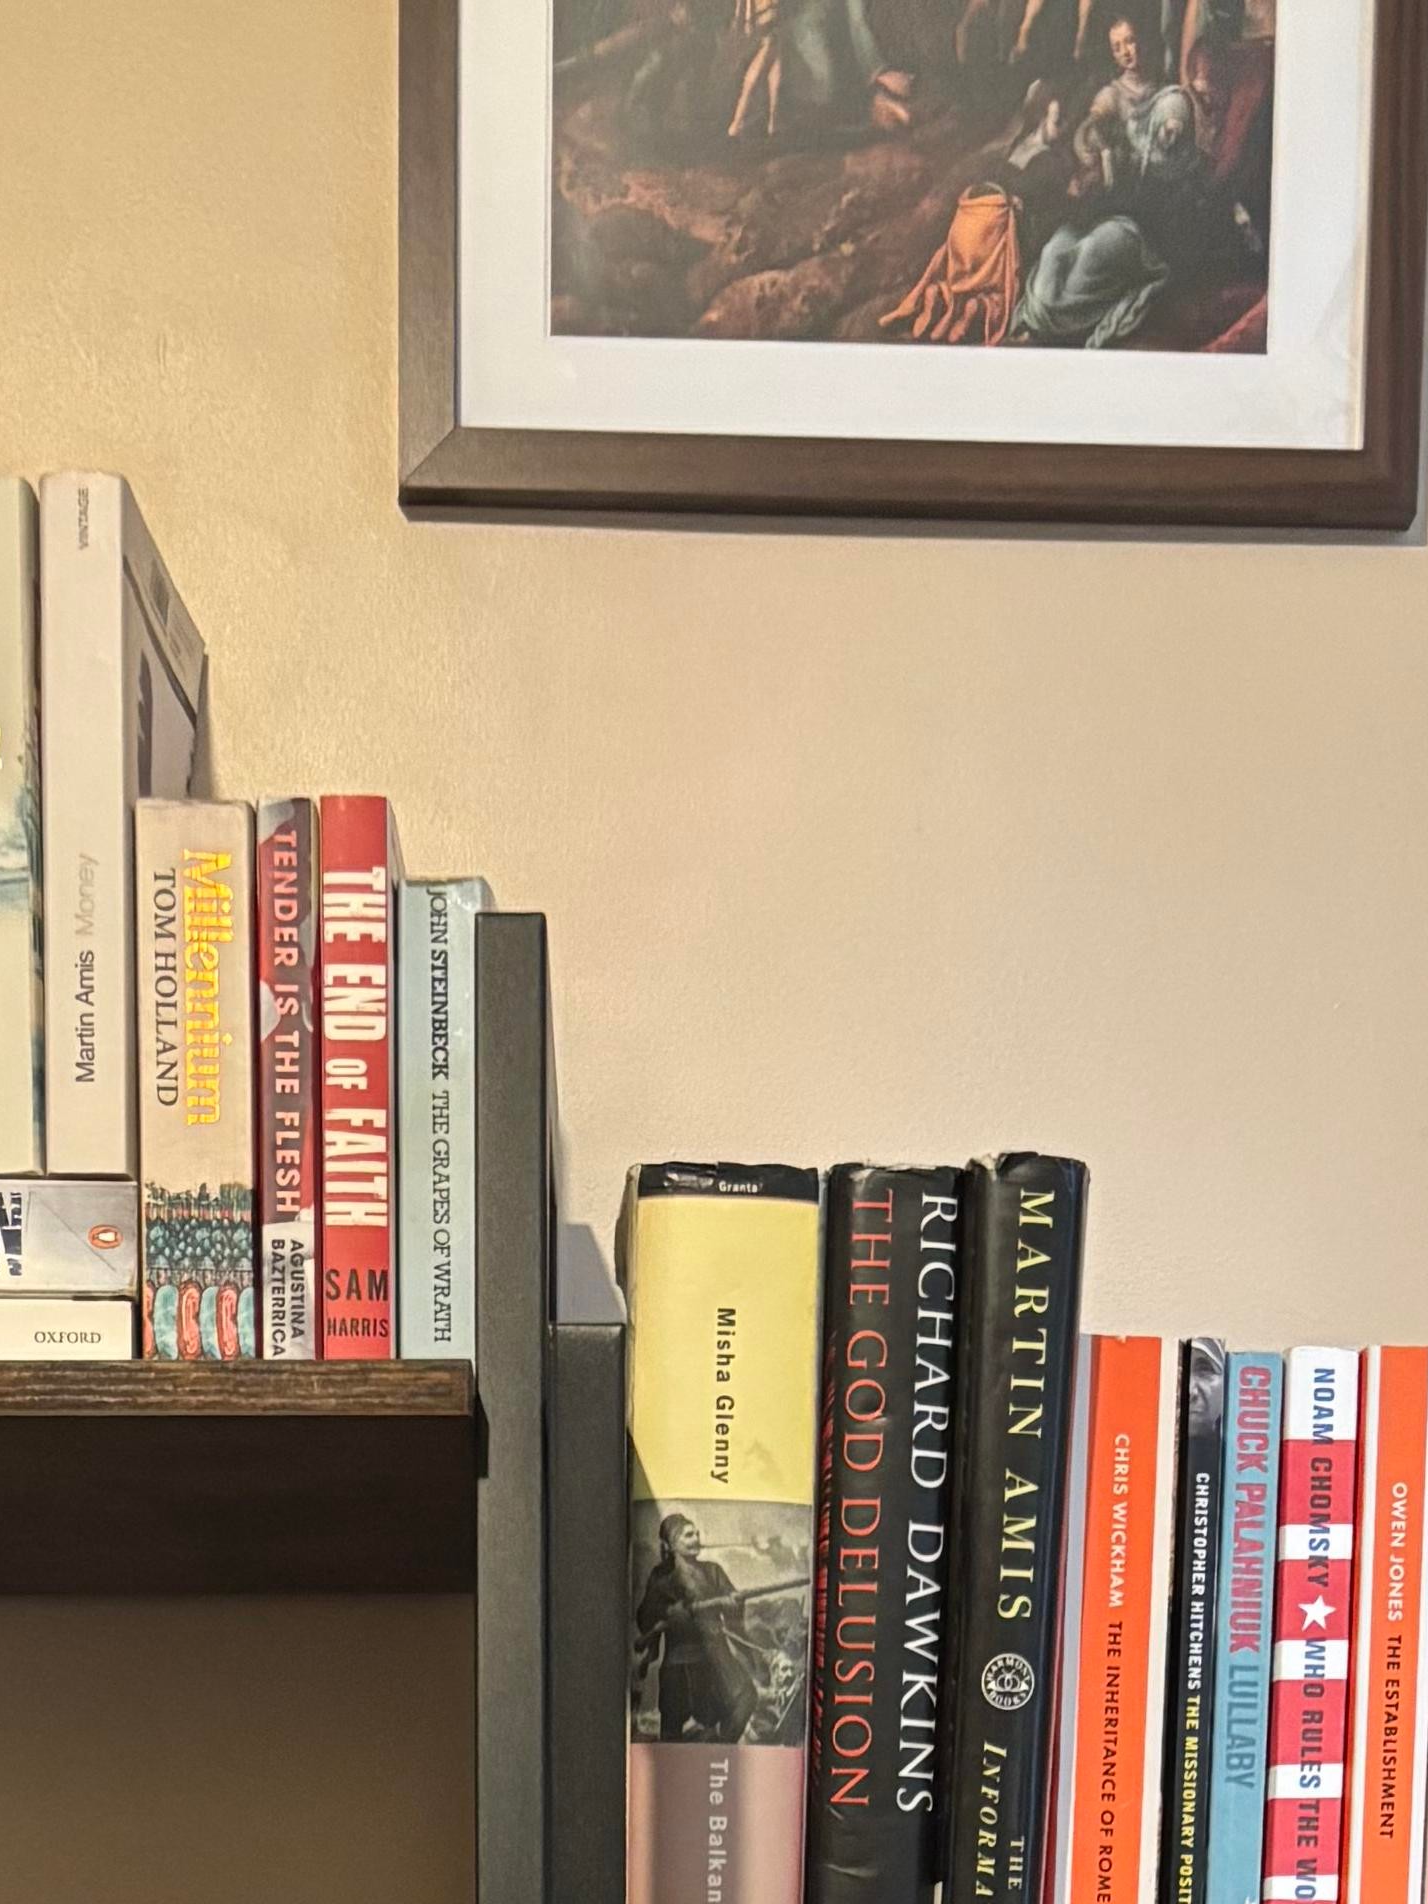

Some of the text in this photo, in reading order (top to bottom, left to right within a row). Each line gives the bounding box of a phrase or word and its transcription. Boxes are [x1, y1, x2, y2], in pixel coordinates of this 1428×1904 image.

[323, 867, 388, 1227] THE END OF FAITH
[34, 1331, 101, 1345] OXFORD
[710, 1307, 736, 1484] Misha Glenny
[829, 1188, 894, 1807] THE GOD DELUSION
[896, 1194, 958, 1813] RICHARD DAWKINS
[1109, 1434, 1130, 1607] CHRIS WICKHAM
